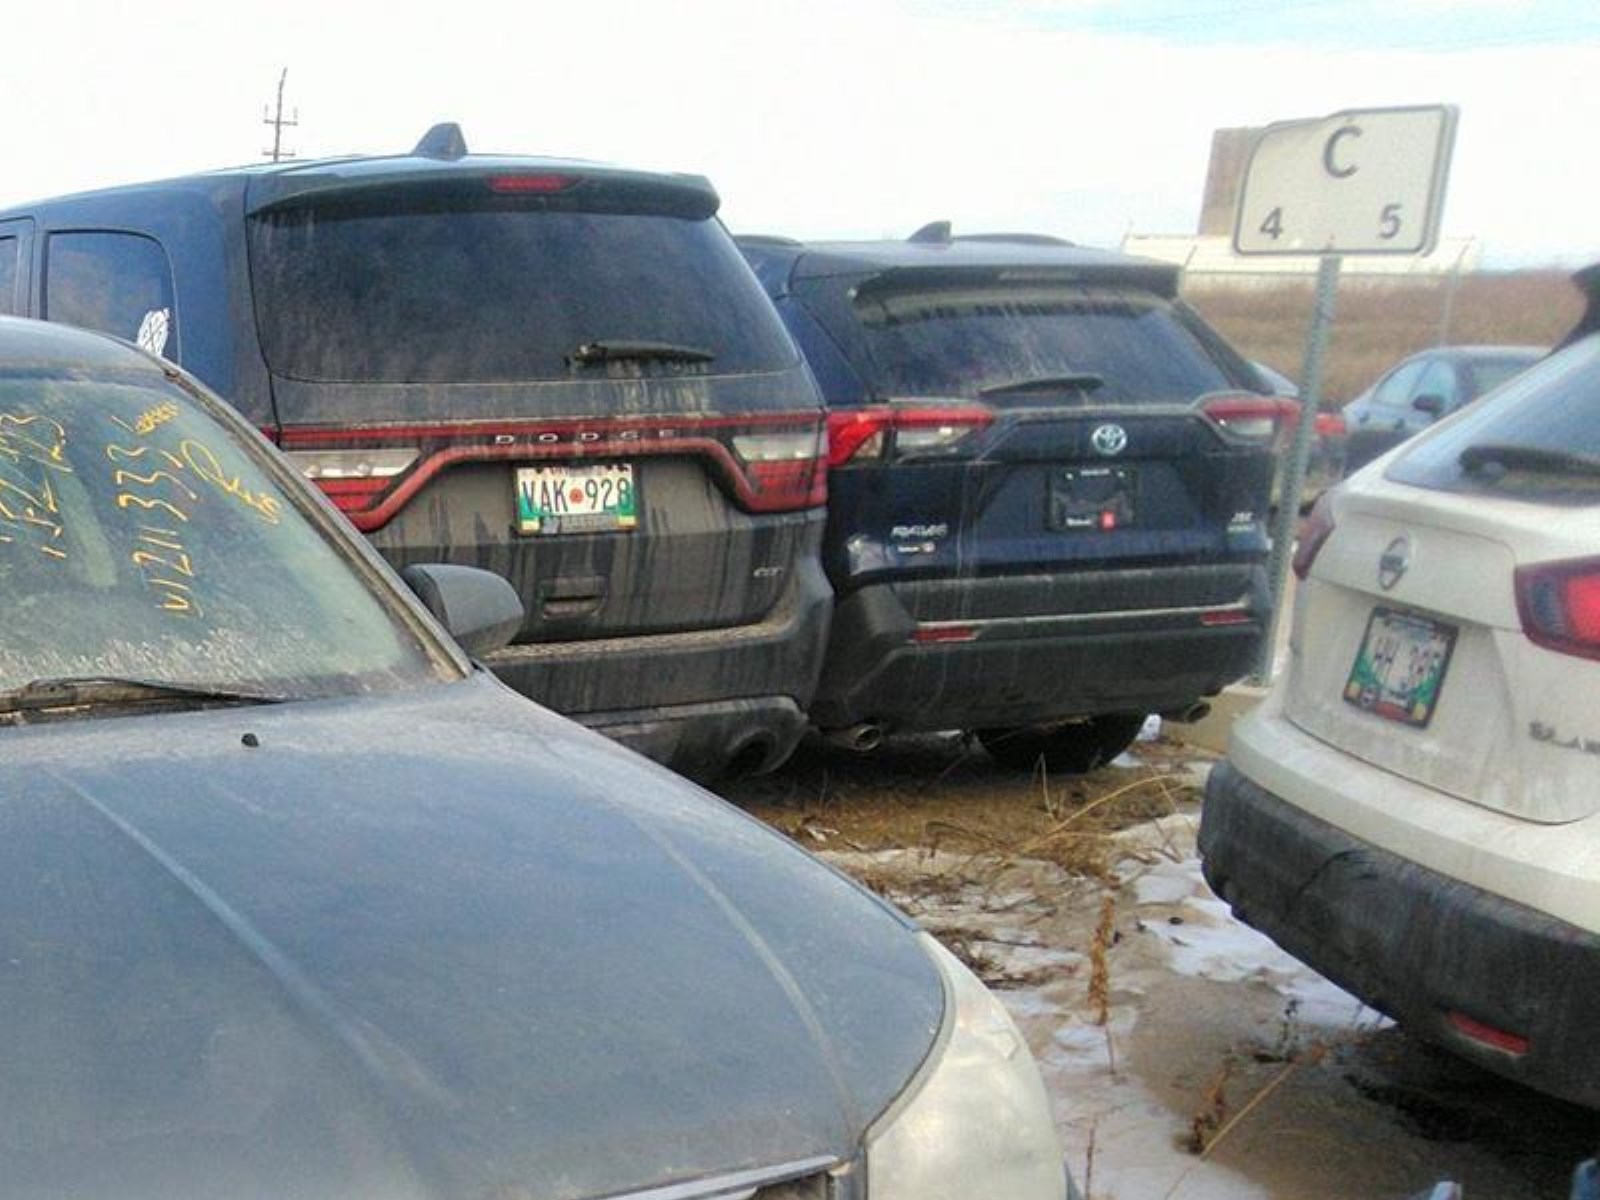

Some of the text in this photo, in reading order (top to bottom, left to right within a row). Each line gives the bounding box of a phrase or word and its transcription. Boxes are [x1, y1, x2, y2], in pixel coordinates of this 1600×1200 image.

[1323, 125, 1362, 178] C
[1259, 203, 1403, 240] 4 5
[495, 428, 675, 444] DODGE
[521, 476, 631, 513] VAK 928
